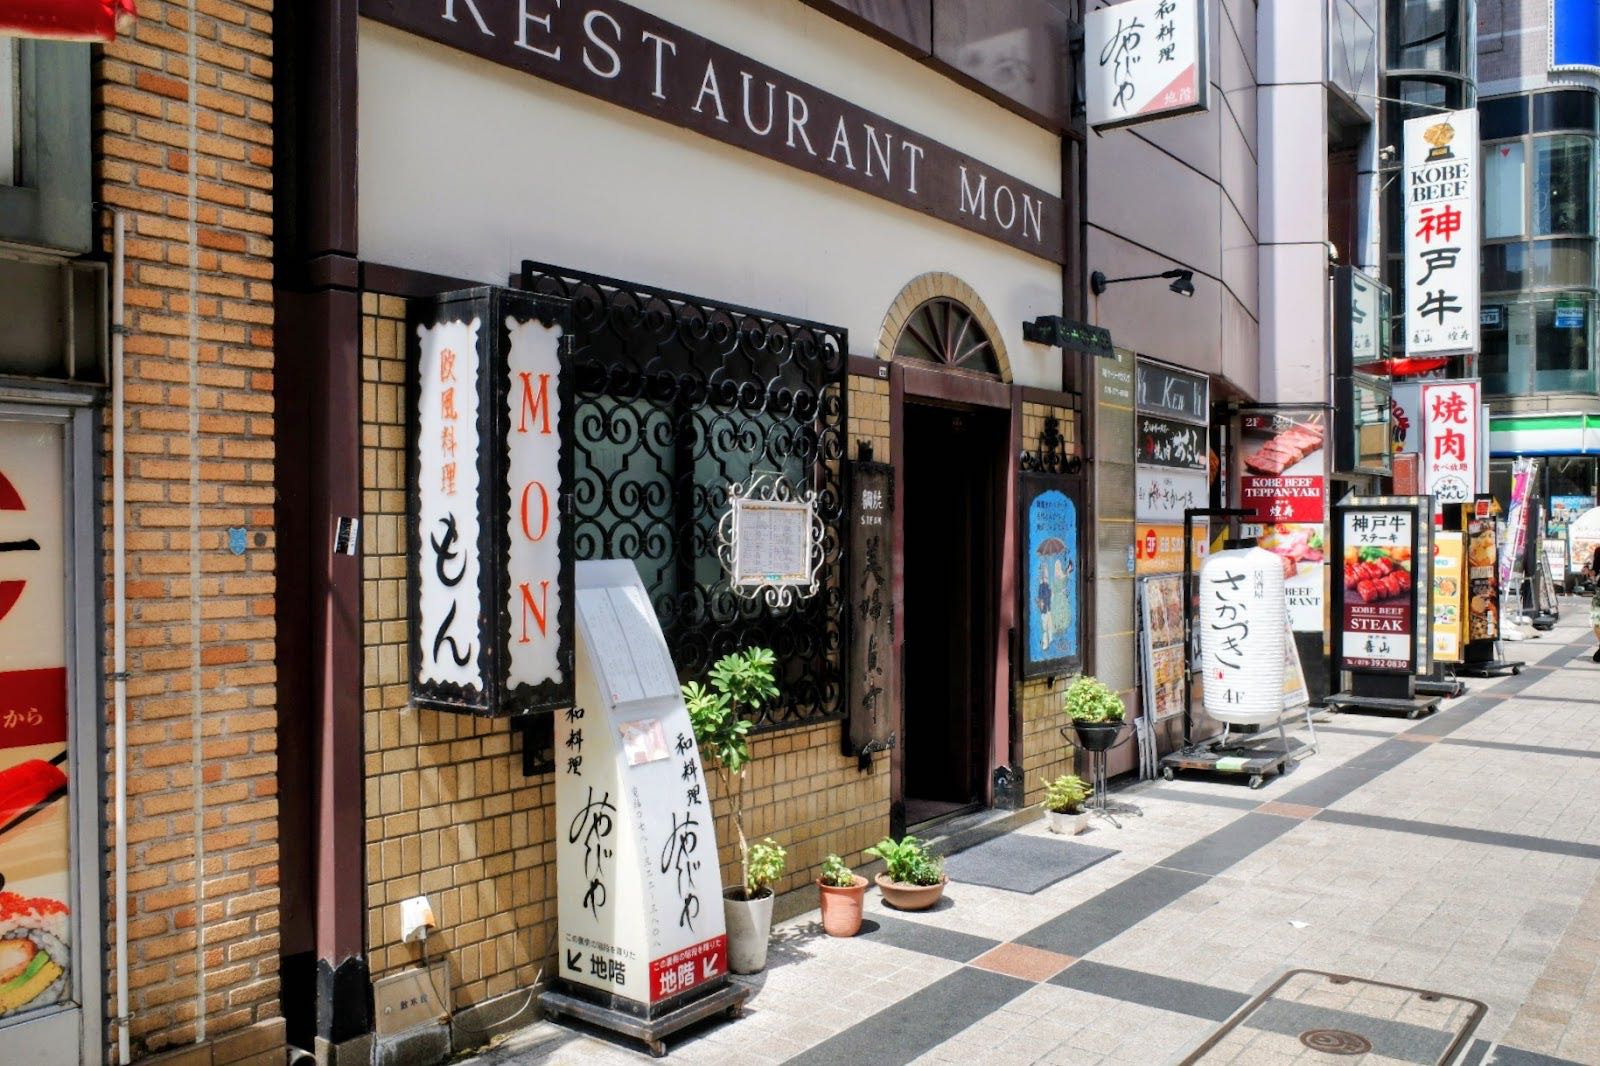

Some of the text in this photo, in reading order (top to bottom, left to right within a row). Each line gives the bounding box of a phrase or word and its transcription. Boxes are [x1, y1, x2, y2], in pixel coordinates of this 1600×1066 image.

[1155, 0, 1176, 63] 和料理
[1411, 163, 1469, 186] KOBE
[960, 166, 1042, 242] MON
[1413, 181, 1467, 202] BEEF
[1415, 205, 1463, 325] 神戸牛
[1432, 391, 1467, 462] 焼肉
[1245, 488, 1320, 497] TEPPAN-YAKI
[1252, 478, 1313, 487] KOBE BEEF
[517, 372, 551, 643] MON
[1352, 515, 1406, 532] 神戸牛
[1360, 533, 1398, 543] ステーキ
[431, 511, 471, 667] もん
[1351, 606, 1404, 615] KOBE BEEF
[1351, 618, 1403, 631] STEAK
[566, 707, 585, 776] 和料理
[675, 732, 702, 807] 和料理
[590, 954, 626, 985] 地階
[659, 960, 695, 995] 地階
